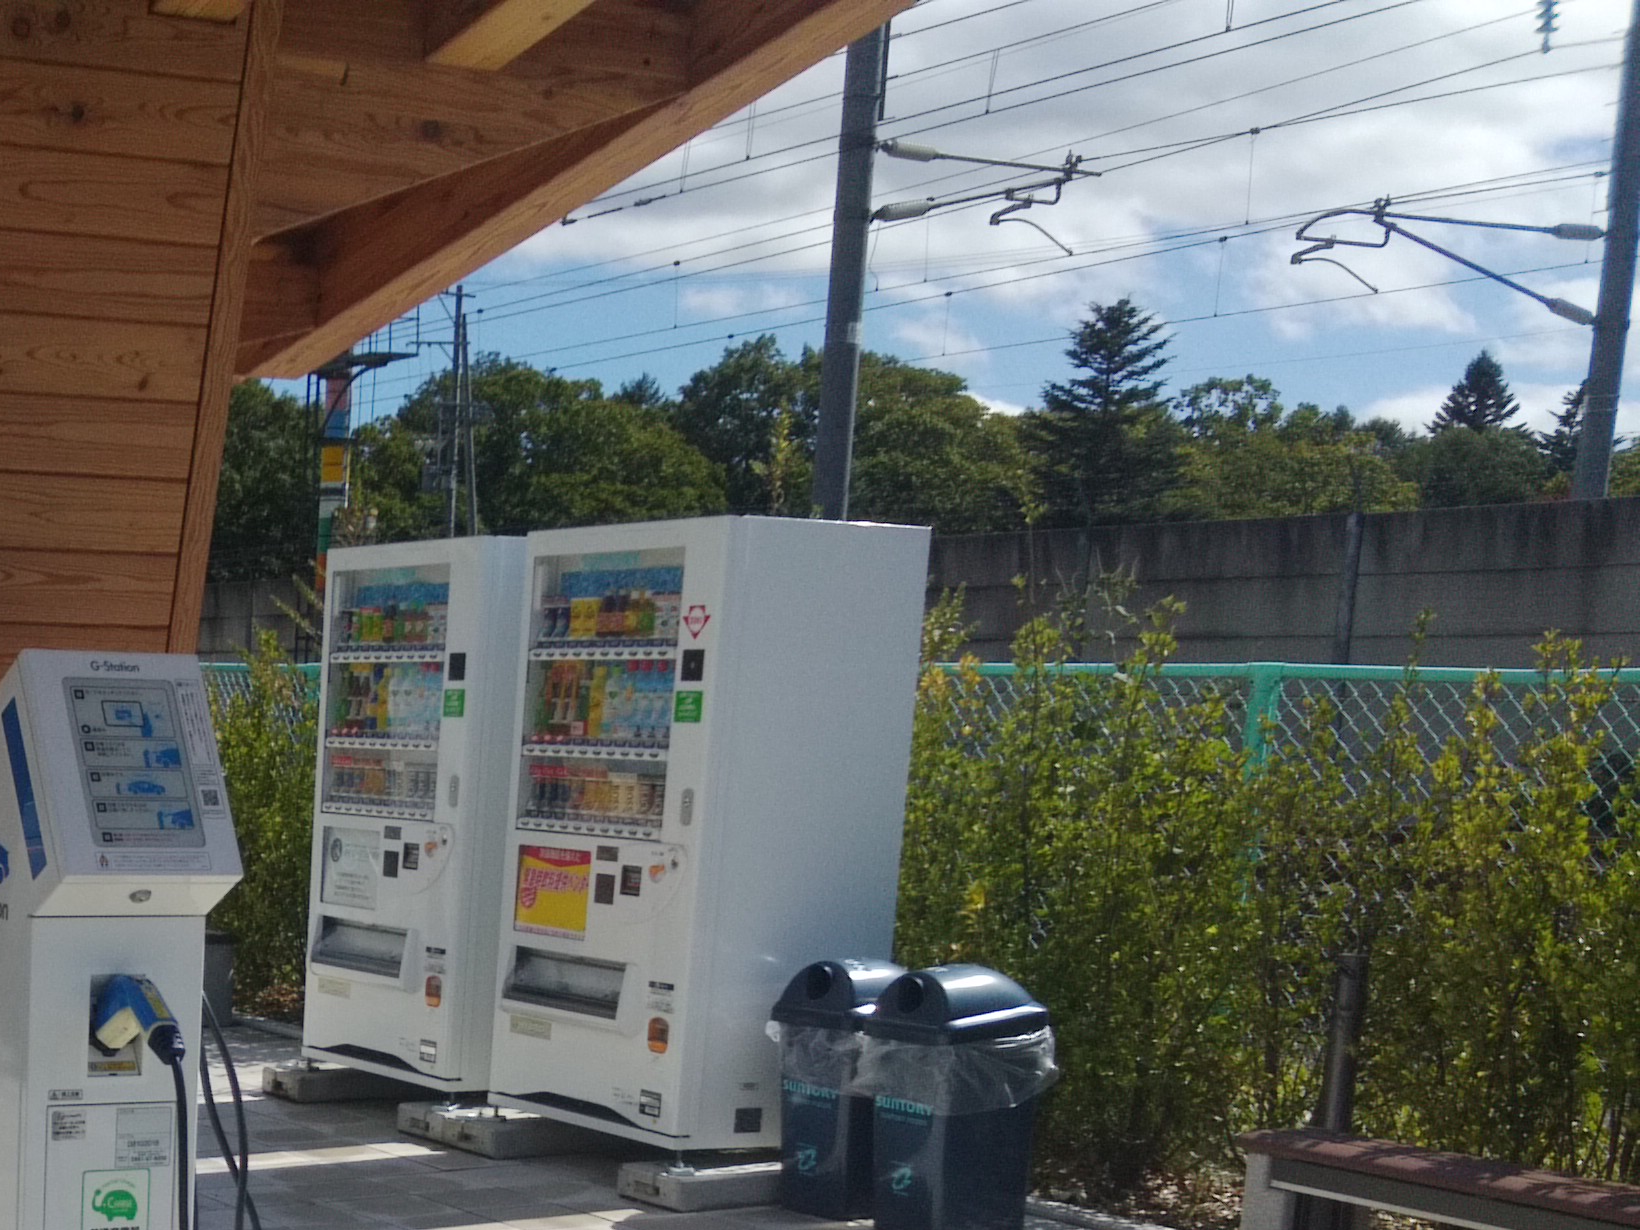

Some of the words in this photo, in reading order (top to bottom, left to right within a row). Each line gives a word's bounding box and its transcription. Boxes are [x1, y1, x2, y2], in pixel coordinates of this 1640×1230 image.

[90, 660, 140, 672] G-Station
[782, 1079, 839, 1099] SUNTORY
[875, 1095, 934, 1116] SUNTORY
